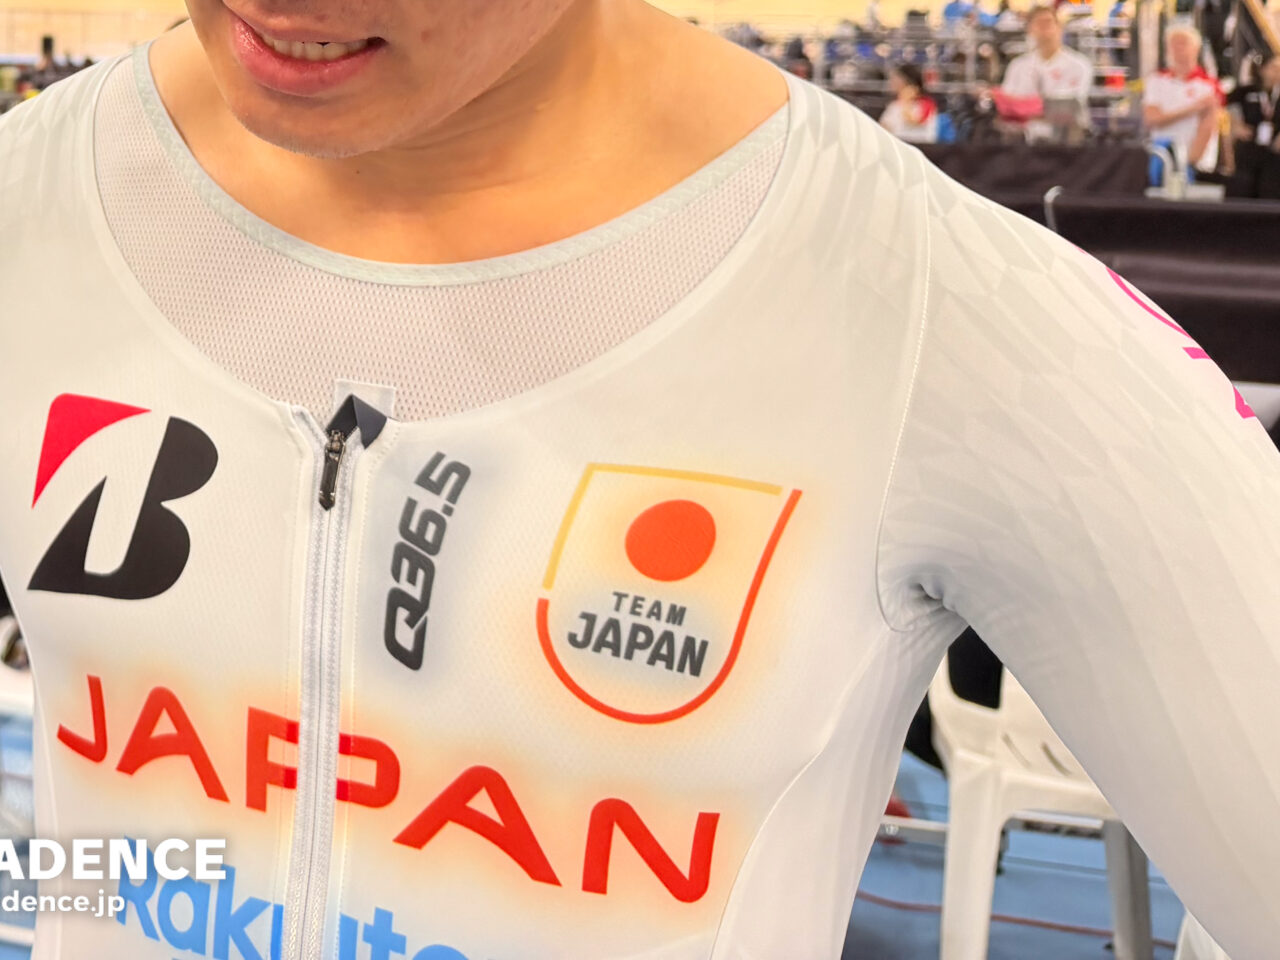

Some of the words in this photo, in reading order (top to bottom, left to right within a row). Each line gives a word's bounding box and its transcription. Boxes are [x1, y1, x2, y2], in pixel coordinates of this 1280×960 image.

[384, 451, 472, 672] Q36.5
[611, 590, 688, 627] TEAM
[566, 610, 710, 678] JAPAN
[56, 674, 721, 904] JAPAN
[116, 834, 494, 960] Rakut
